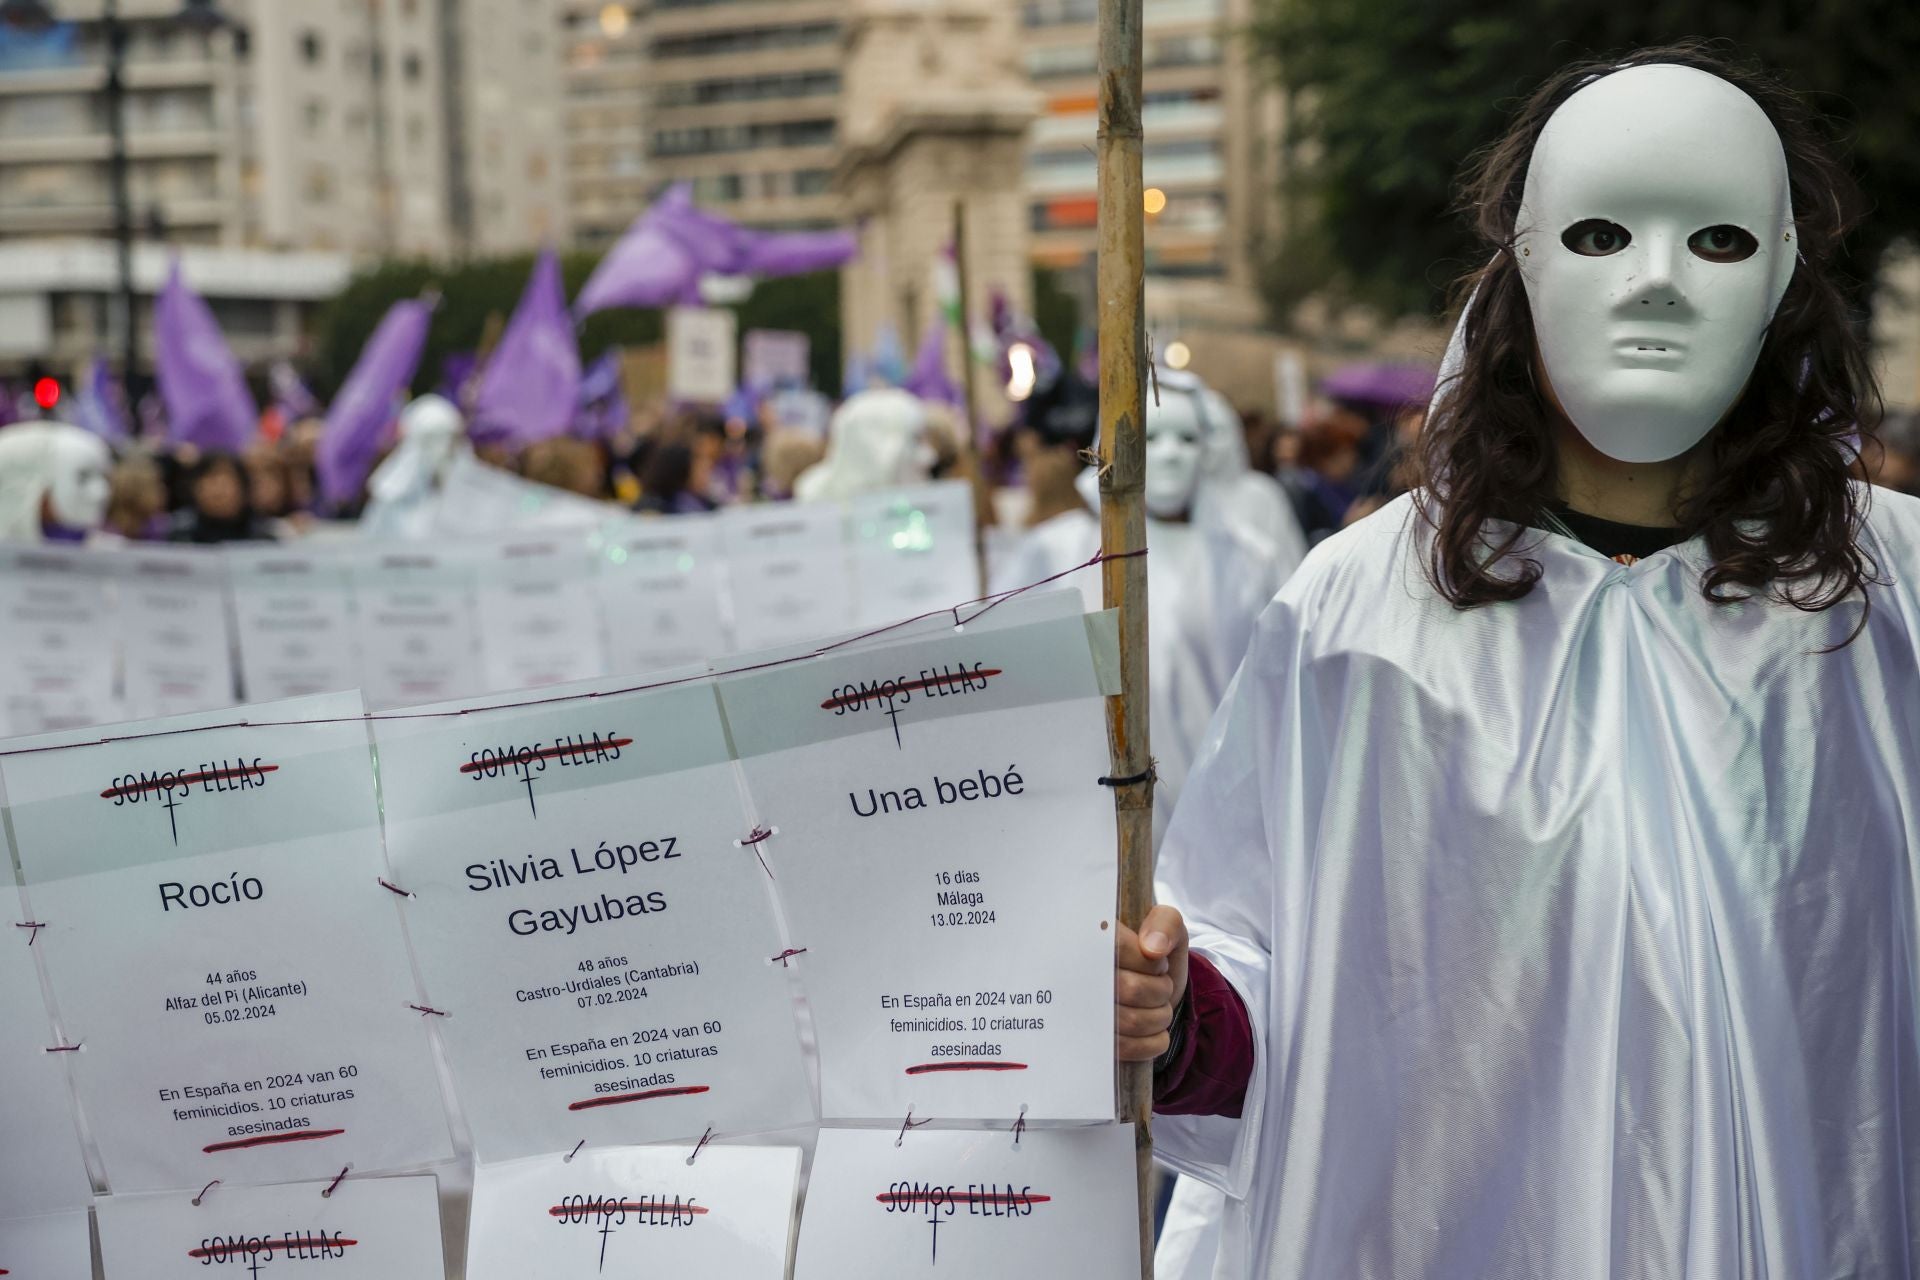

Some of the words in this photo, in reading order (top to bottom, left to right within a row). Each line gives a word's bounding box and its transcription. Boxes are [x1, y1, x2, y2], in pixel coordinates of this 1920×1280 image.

[831, 675, 911, 716] SOMOS
[920, 662, 987, 698] ELLAS
[471, 743, 546, 780] SOMOS
[556, 732, 621, 766] ELLAS
[113, 769, 189, 806] SOMOS
[200, 758, 266, 792] ELLAS
[850, 785, 927, 817] Una
[933, 764, 1025, 805] bebé
[465, 856, 563, 892] Silvia
[571, 836, 681, 874] López
[935, 871, 951, 885] 16
[159, 872, 263, 911] Rocío
[937, 890, 984, 907] Málaga
[508, 891, 667, 935] Gayubas
[930, 910, 996, 927] 13.02.2024
[206, 972, 222, 986] 44
[226, 968, 257, 983] años
[577, 960, 594, 973] 48
[598, 955, 628, 969] años
[165, 994, 198, 1011] Alfaz
[201, 991, 222, 1006] del
[225, 989, 239, 1003] Pi
[242, 980, 307, 1004] (Alicante)
[516, 975, 621, 1003] Castro-Urdiales
[624, 960, 700, 987] (Cantabria)
[577, 987, 648, 1009] 07.02.2024
[204, 1004, 276, 1025] 05.02.2024
[881, 995, 900, 1009] En
[903, 993, 952, 1010] España
[955, 995, 972, 1007] en
[975, 991, 1006, 1006] 2024
[1009, 993, 1033, 1005] van
[1036, 990, 1052, 1004] 60
[525, 1047, 547, 1061] En
[551, 1038, 606, 1057] España
[610, 1035, 629, 1048] en
[632, 1028, 669, 1044] 2024
[672, 1025, 700, 1039] van
[703, 1020, 722, 1035] 60
[890, 1017, 967, 1033] feminicidios.
[971, 1017, 986, 1031] 10
[990, 1015, 1044, 1031] criaturas
[539, 1057, 630, 1080] feminicidios.
[633, 1052, 652, 1067] 10
[655, 1044, 719, 1064] criaturas
[931, 1042, 1002, 1057] asesinadas
[159, 1088, 180, 1102] En
[183, 1081, 240, 1100] España
[244, 1079, 263, 1092] en
[266, 1073, 303, 1090] 2024
[307, 1069, 335, 1083] van
[338, 1065, 358, 1080] 60
[594, 1070, 675, 1094] asesinadas
[173, 1100, 264, 1122] feminicidios.
[268, 1096, 286, 1111] 10
[291, 1087, 354, 1108] criaturas
[228, 1115, 310, 1137] asesinadas
[558, 1195, 627, 1225] SOMOS
[638, 1195, 696, 1227] ELLAS
[886, 1181, 955, 1216] SOMOS
[968, 1183, 1033, 1218] ELLAS
[202, 1235, 273, 1265] SOMOS
[286, 1230, 344, 1260] ELLAS
